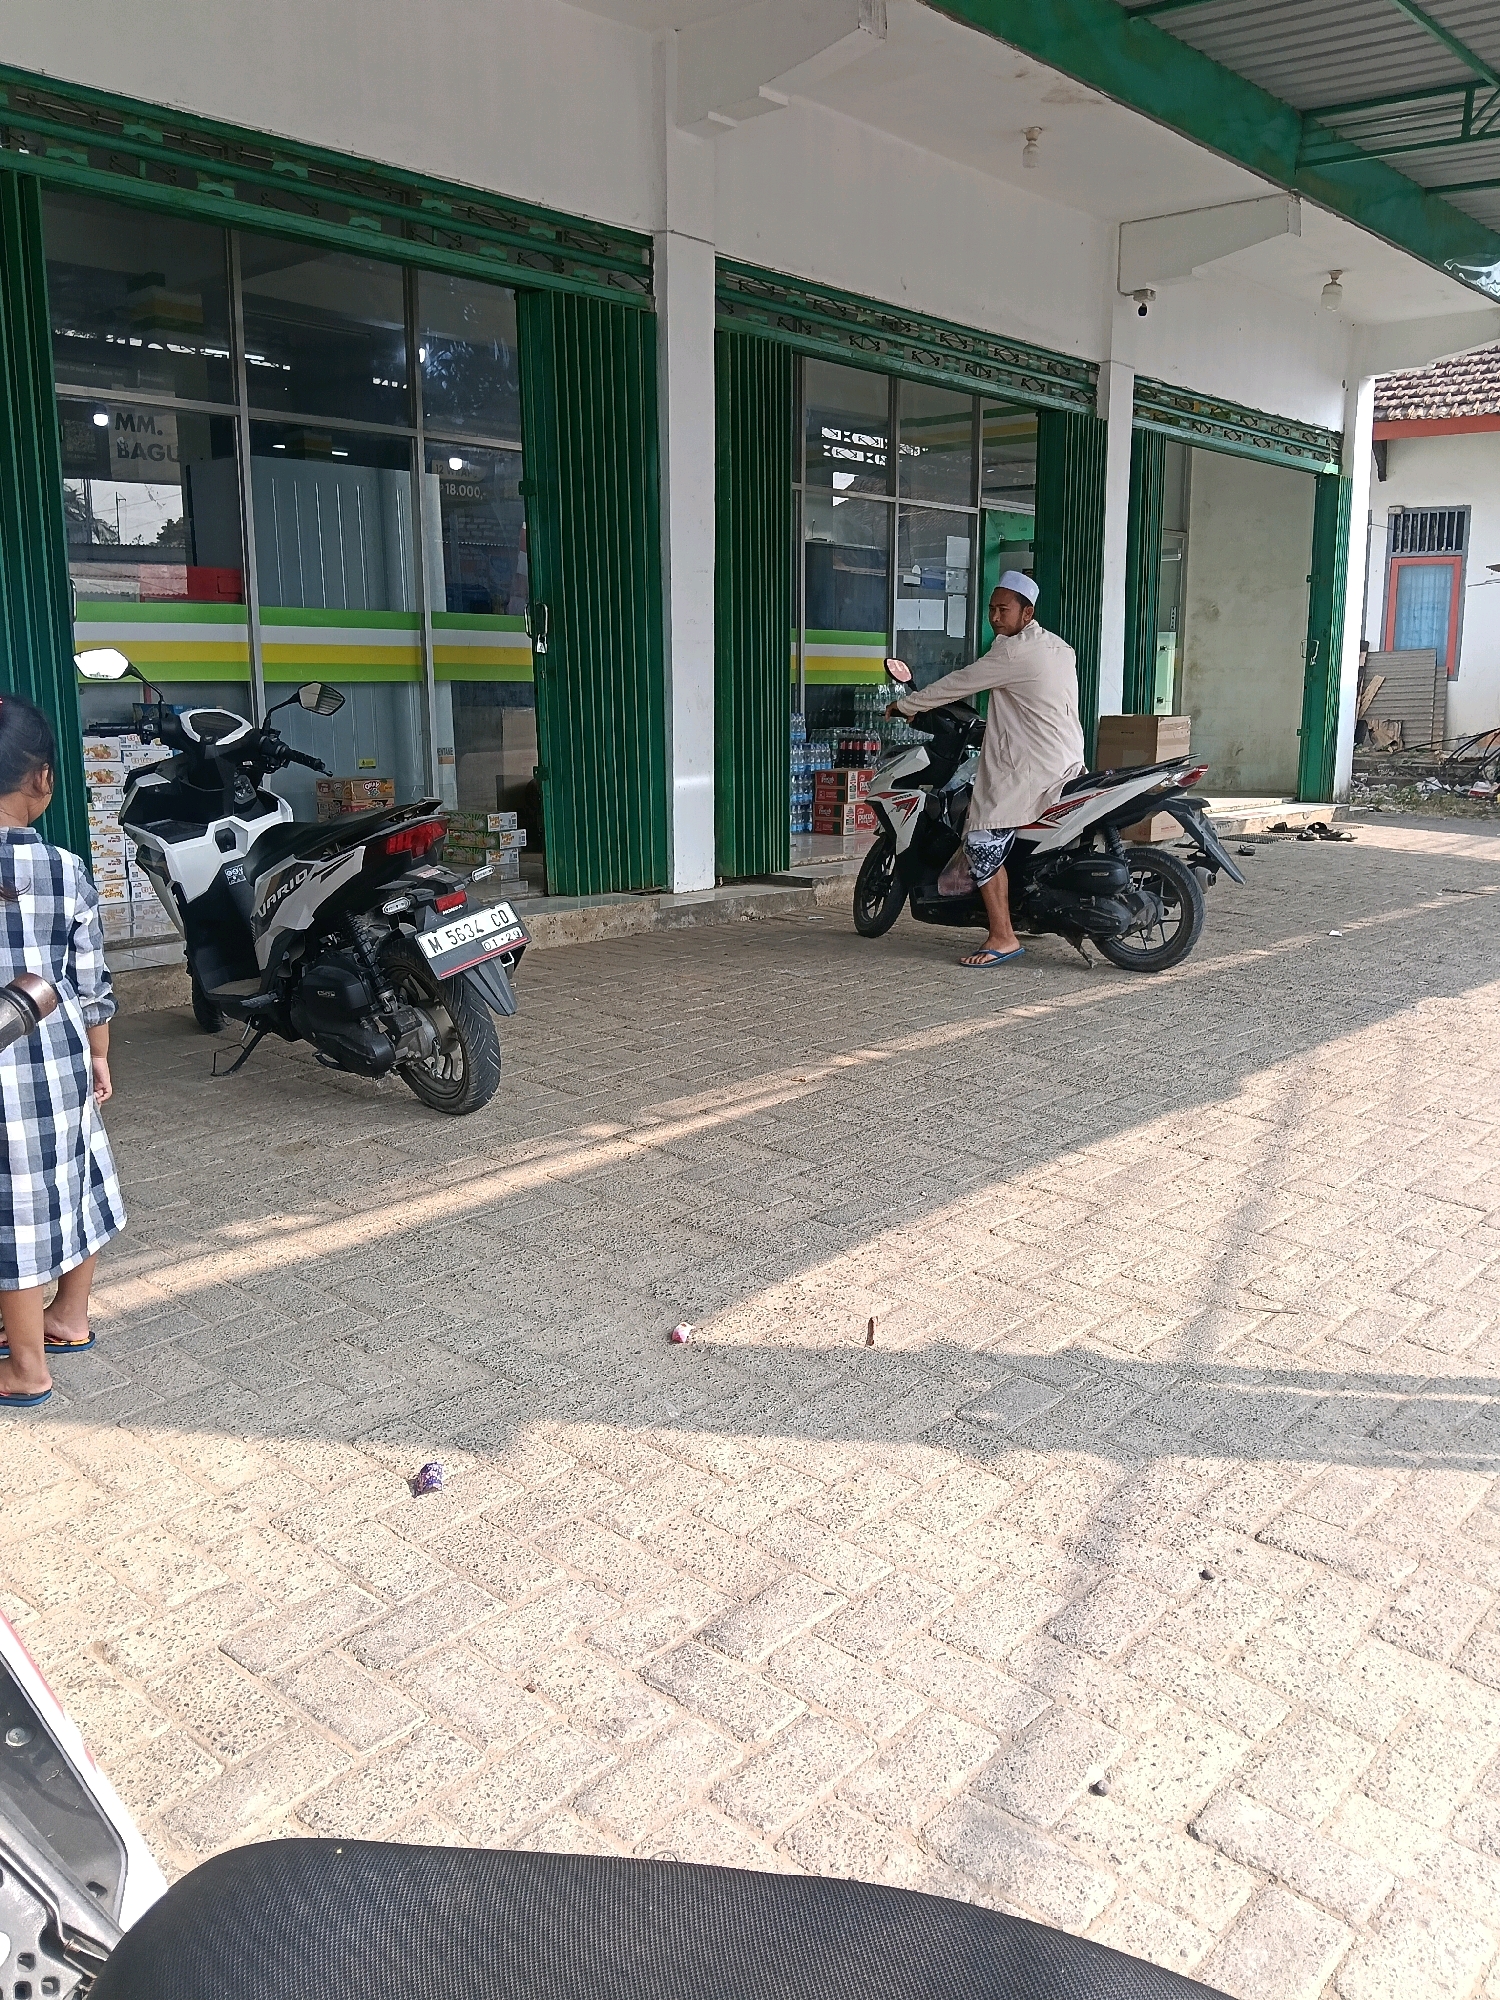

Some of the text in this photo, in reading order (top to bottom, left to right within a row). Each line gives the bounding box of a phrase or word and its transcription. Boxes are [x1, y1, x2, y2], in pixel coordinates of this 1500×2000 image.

[115, 412, 163, 436] MM.
[257, 868, 308, 918] VARIO
[442, 904, 464, 915] HONDA
[427, 936, 443, 953] M
